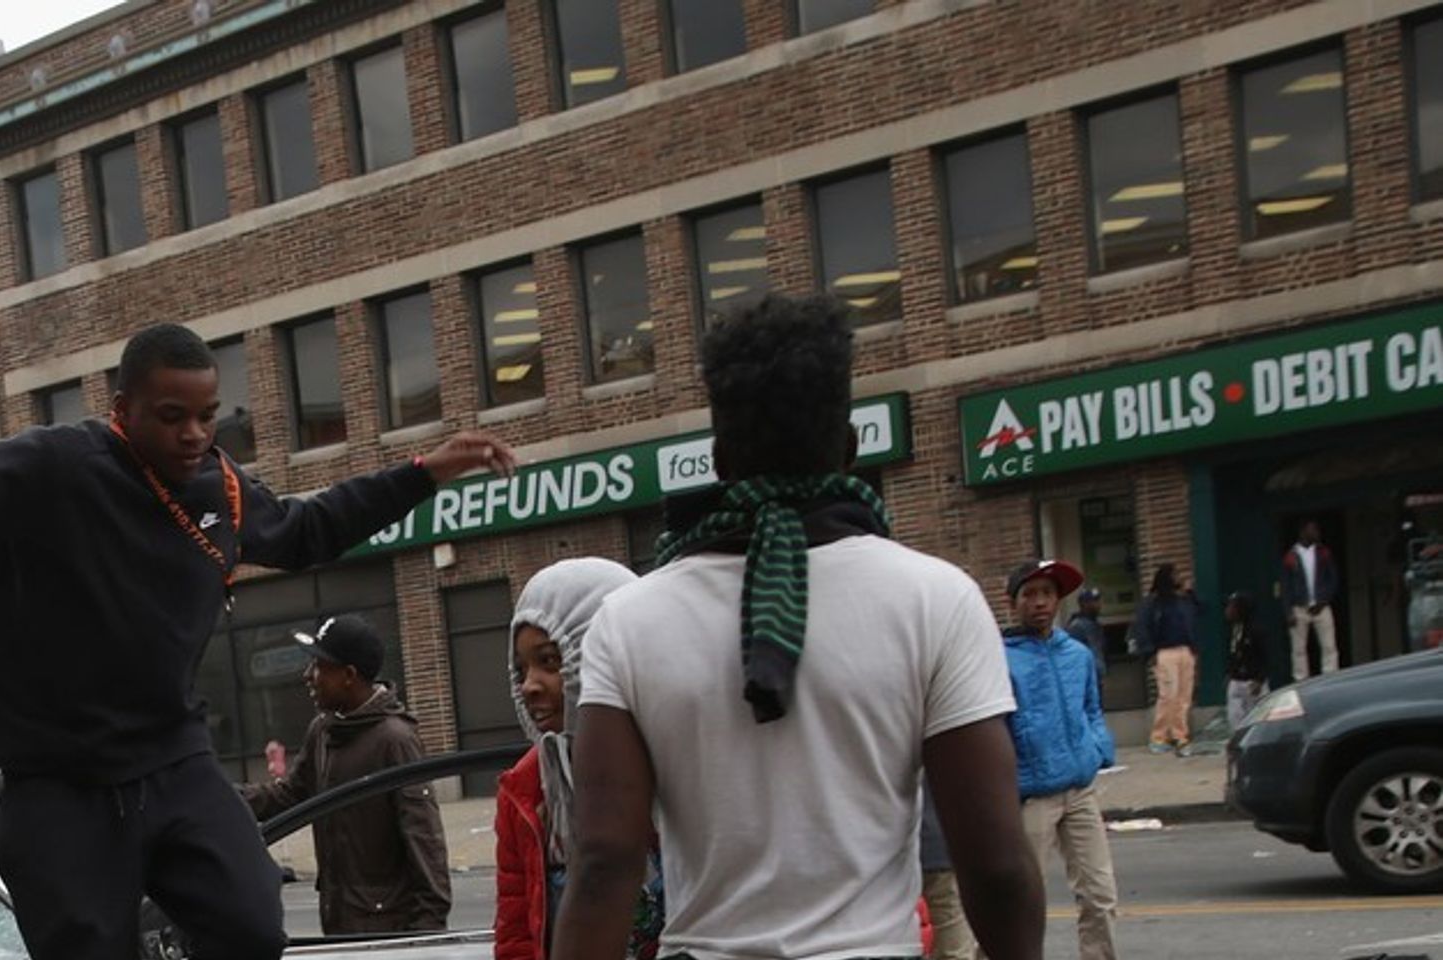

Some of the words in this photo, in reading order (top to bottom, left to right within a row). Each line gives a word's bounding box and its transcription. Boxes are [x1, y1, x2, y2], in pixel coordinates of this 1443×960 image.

[1039, 390, 1104, 455] PAY
[1113, 370, 1217, 441] BILLS
[1251, 339, 1373, 417] DEBIT
[669, 453, 716, 480] fas
[982, 454, 1035, 480] ACE
[432, 454, 635, 535] REFUNDS
